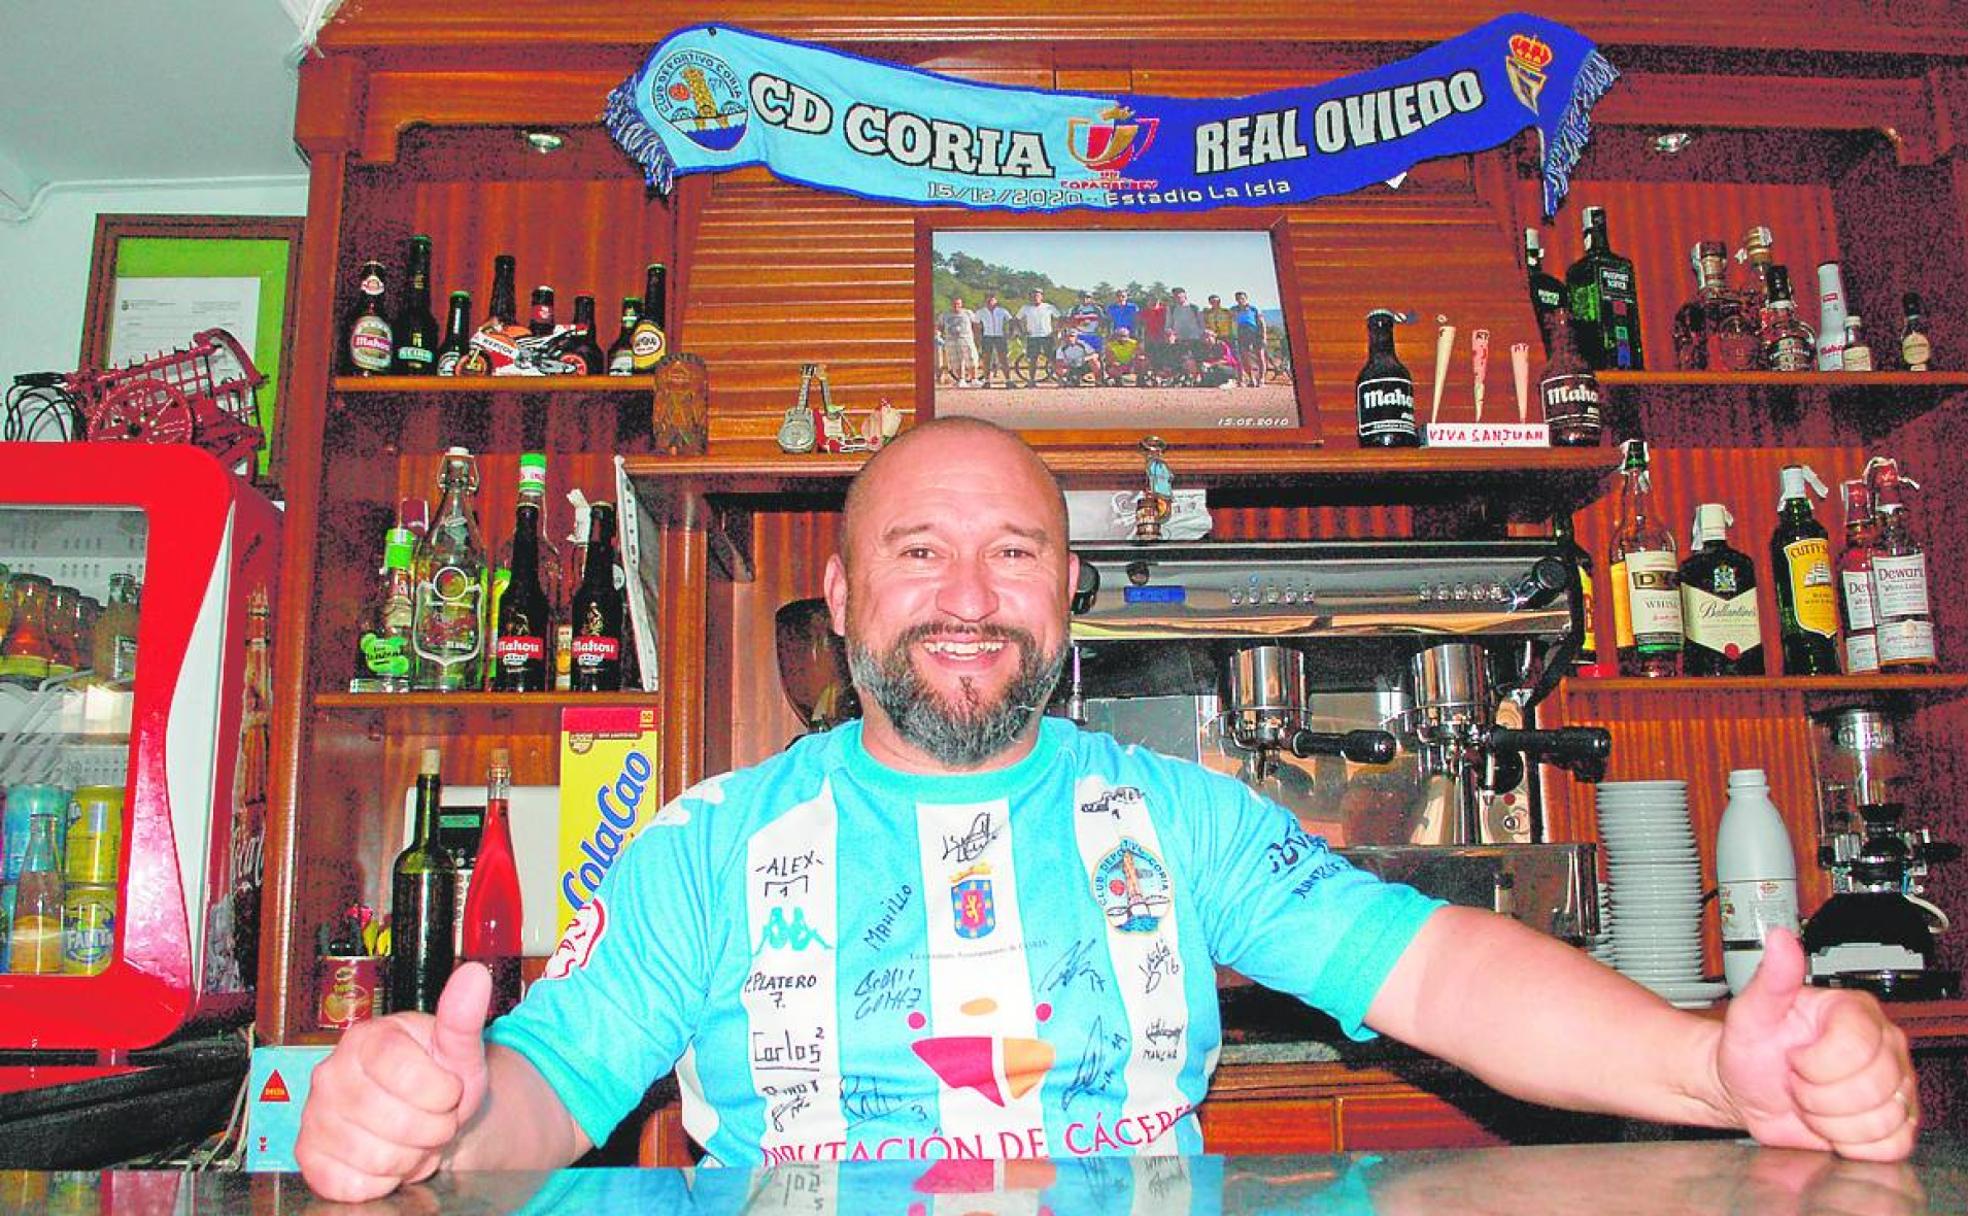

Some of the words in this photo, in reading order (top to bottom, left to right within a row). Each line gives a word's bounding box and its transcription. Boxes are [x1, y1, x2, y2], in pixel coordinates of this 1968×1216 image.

[749, 74, 832, 134] CD
[844, 103, 1055, 177] CORIA
[1195, 108, 1308, 174] REAL
[1313, 70, 1484, 154] OVIEDO
[928, 182, 1081, 206] 15/12/2020
[1104, 187, 1203, 206] Estadio
[1208, 184, 1239, 199] La
[1245, 178, 1291, 197] Isla
[1430, 430, 1465, 441] VIVA
[562, 750, 652, 912] ColaCao
[1096, 876, 1107, 906] CLUB
[753, 1029, 821, 1064] Carlos
[815, 1026, 825, 1039] 2
[999, 1127, 1046, 1159] DE
